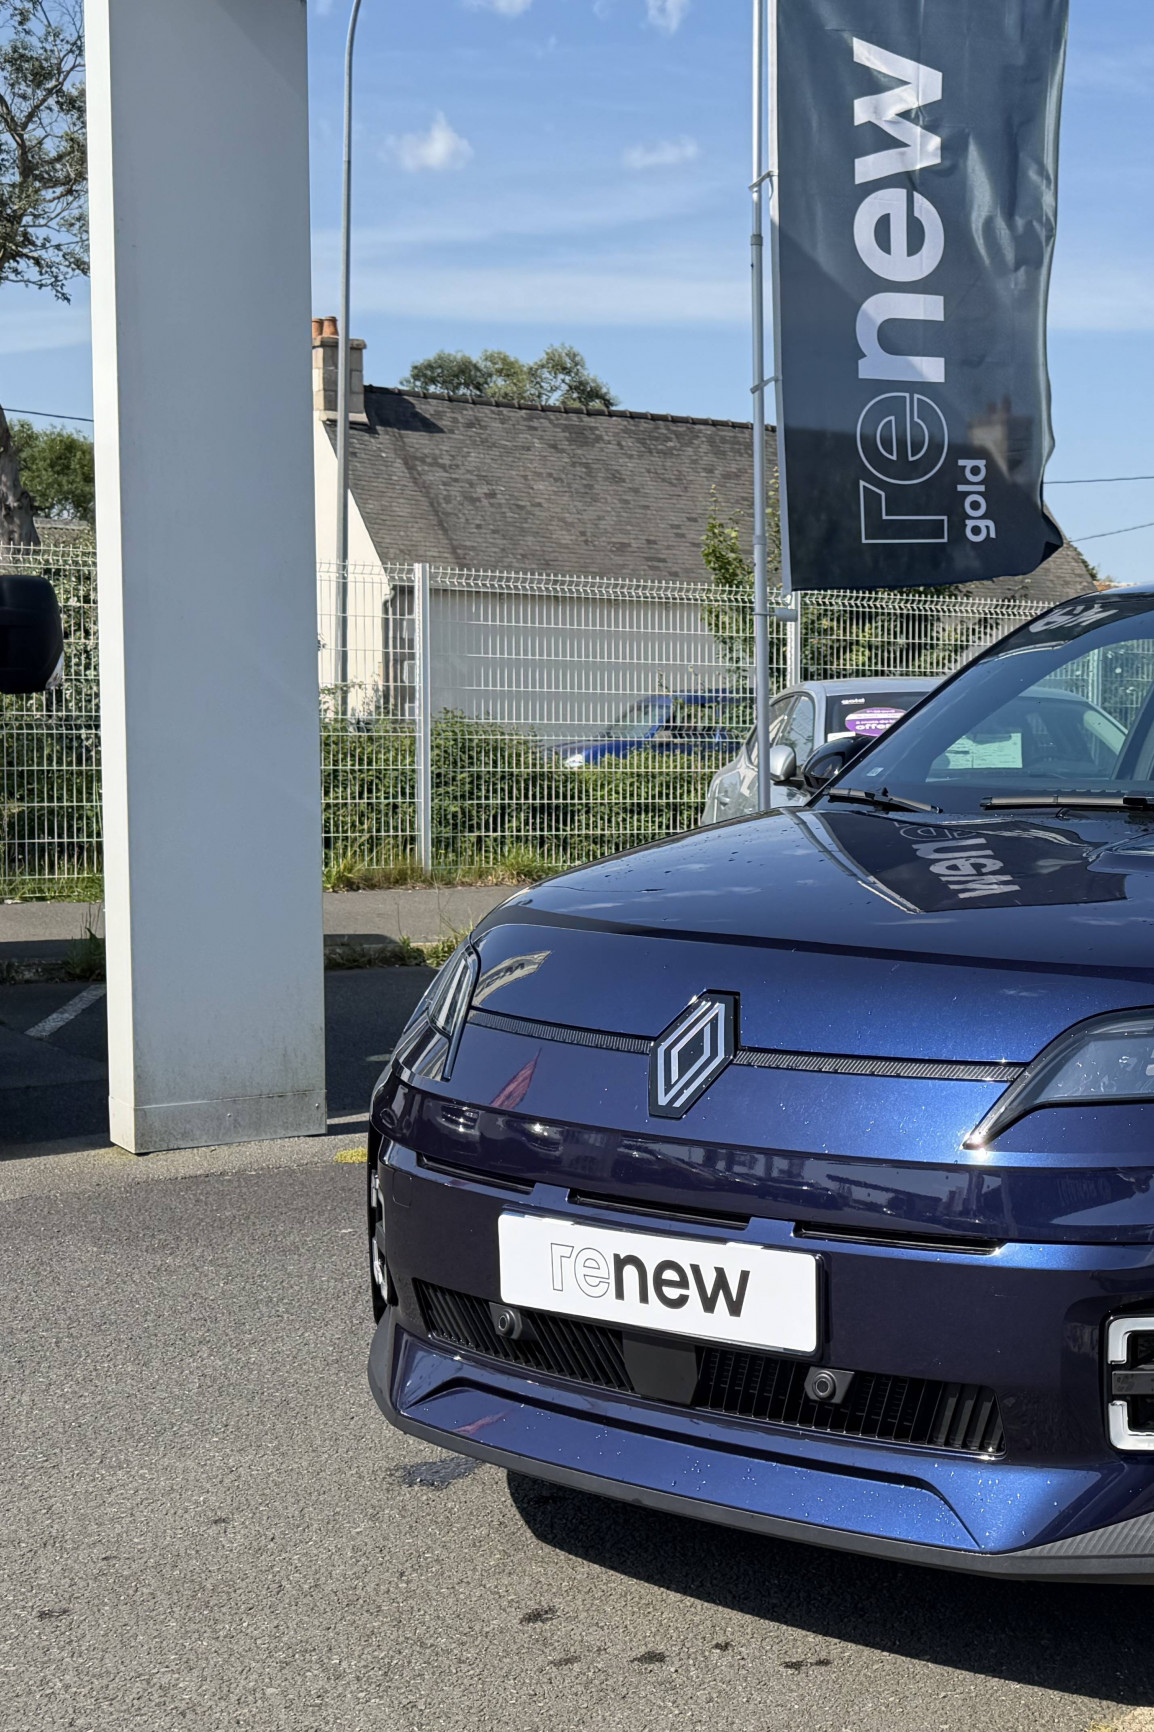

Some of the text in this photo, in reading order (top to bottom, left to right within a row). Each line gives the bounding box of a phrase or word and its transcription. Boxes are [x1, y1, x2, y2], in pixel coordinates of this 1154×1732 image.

[852, 37, 948, 544] renew
[957, 459, 996, 543] gold
[550, 1242, 750, 1318] renew
